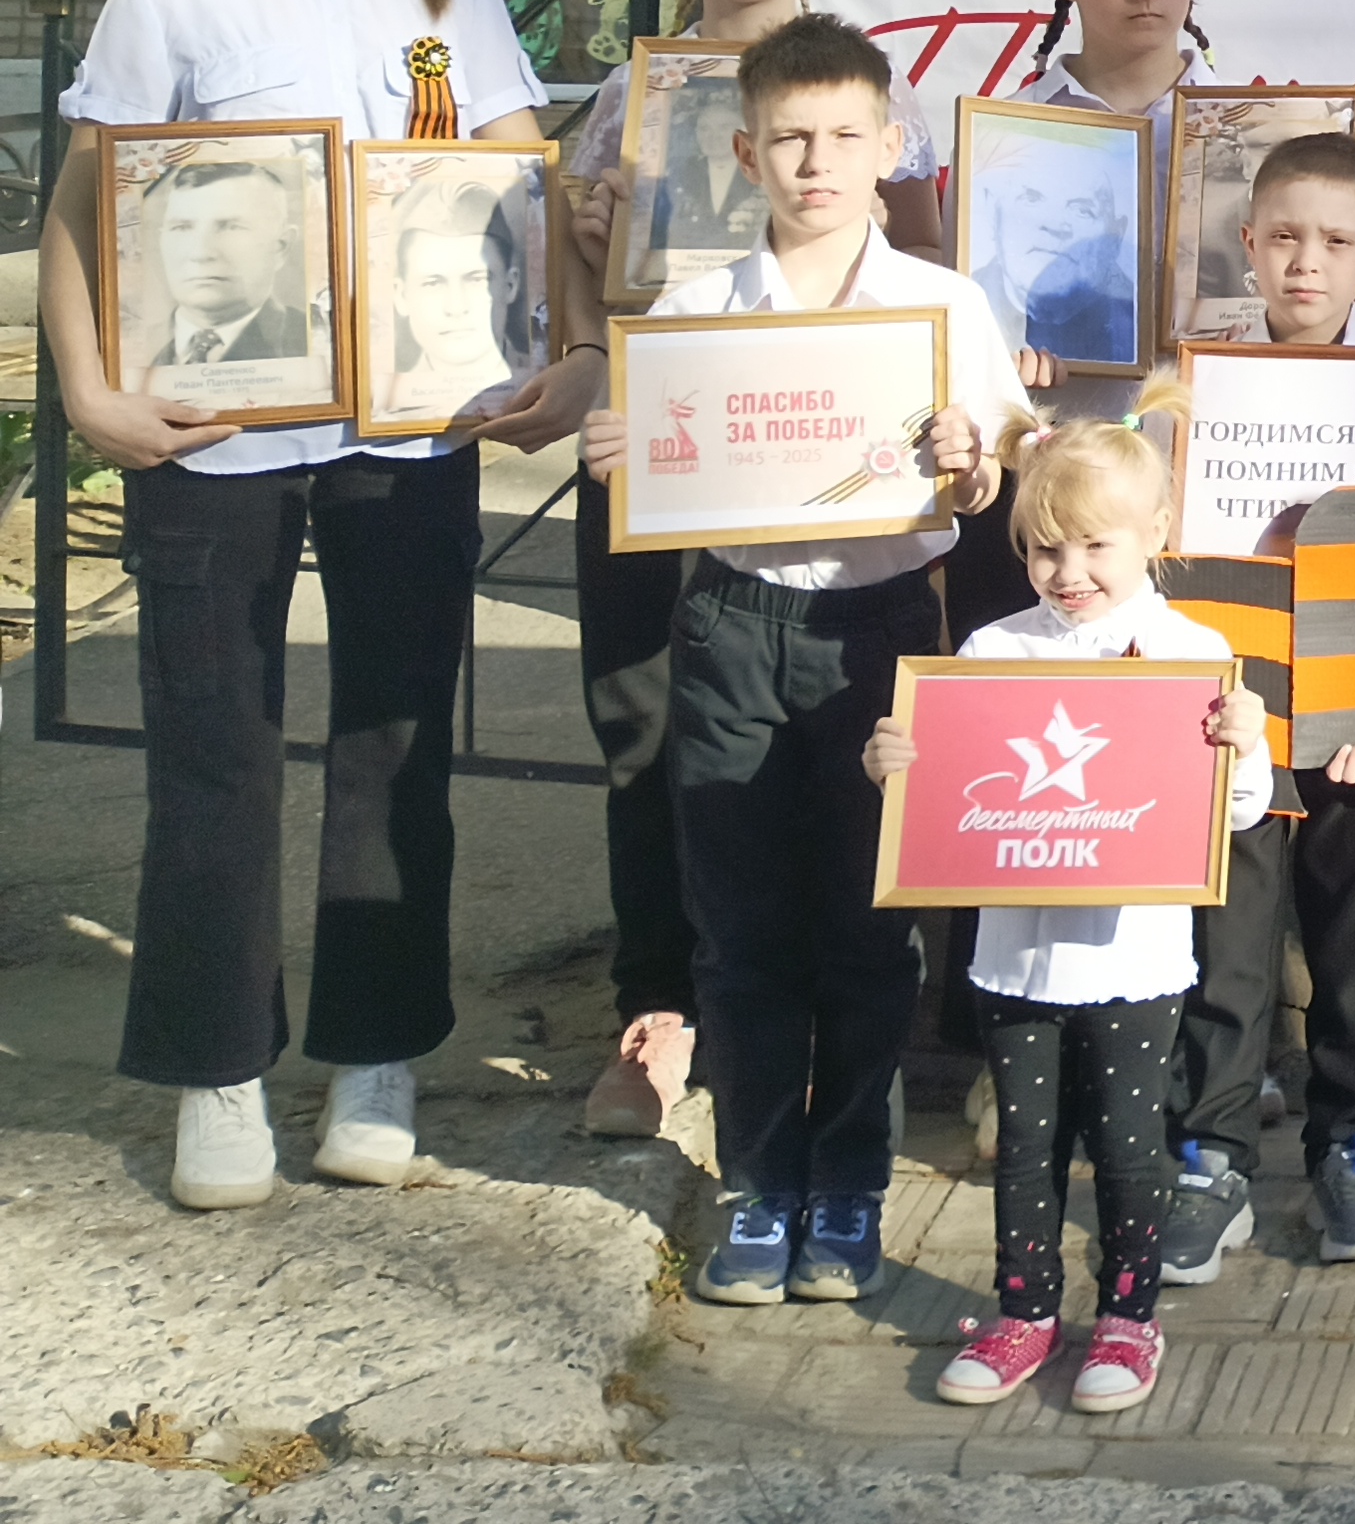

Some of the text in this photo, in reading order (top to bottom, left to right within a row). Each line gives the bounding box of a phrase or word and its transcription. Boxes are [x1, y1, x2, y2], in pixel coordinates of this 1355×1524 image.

[174, 376, 283, 390] Иван Пантелеевич
[201, 366, 256, 377] Савченко
[727, 390, 834, 414] СПАСИБО
[727, 416, 865, 443] ЗА ПОБЕДУ!
[1192, 420, 1355, 449] ГОРДИМСЯ
[728, 451, 765, 465] 1945
[782, 448, 822, 464] 2025
[1204, 459, 1345, 482] ПОМНИМ
[996, 838, 1100, 869] ПОЛК
